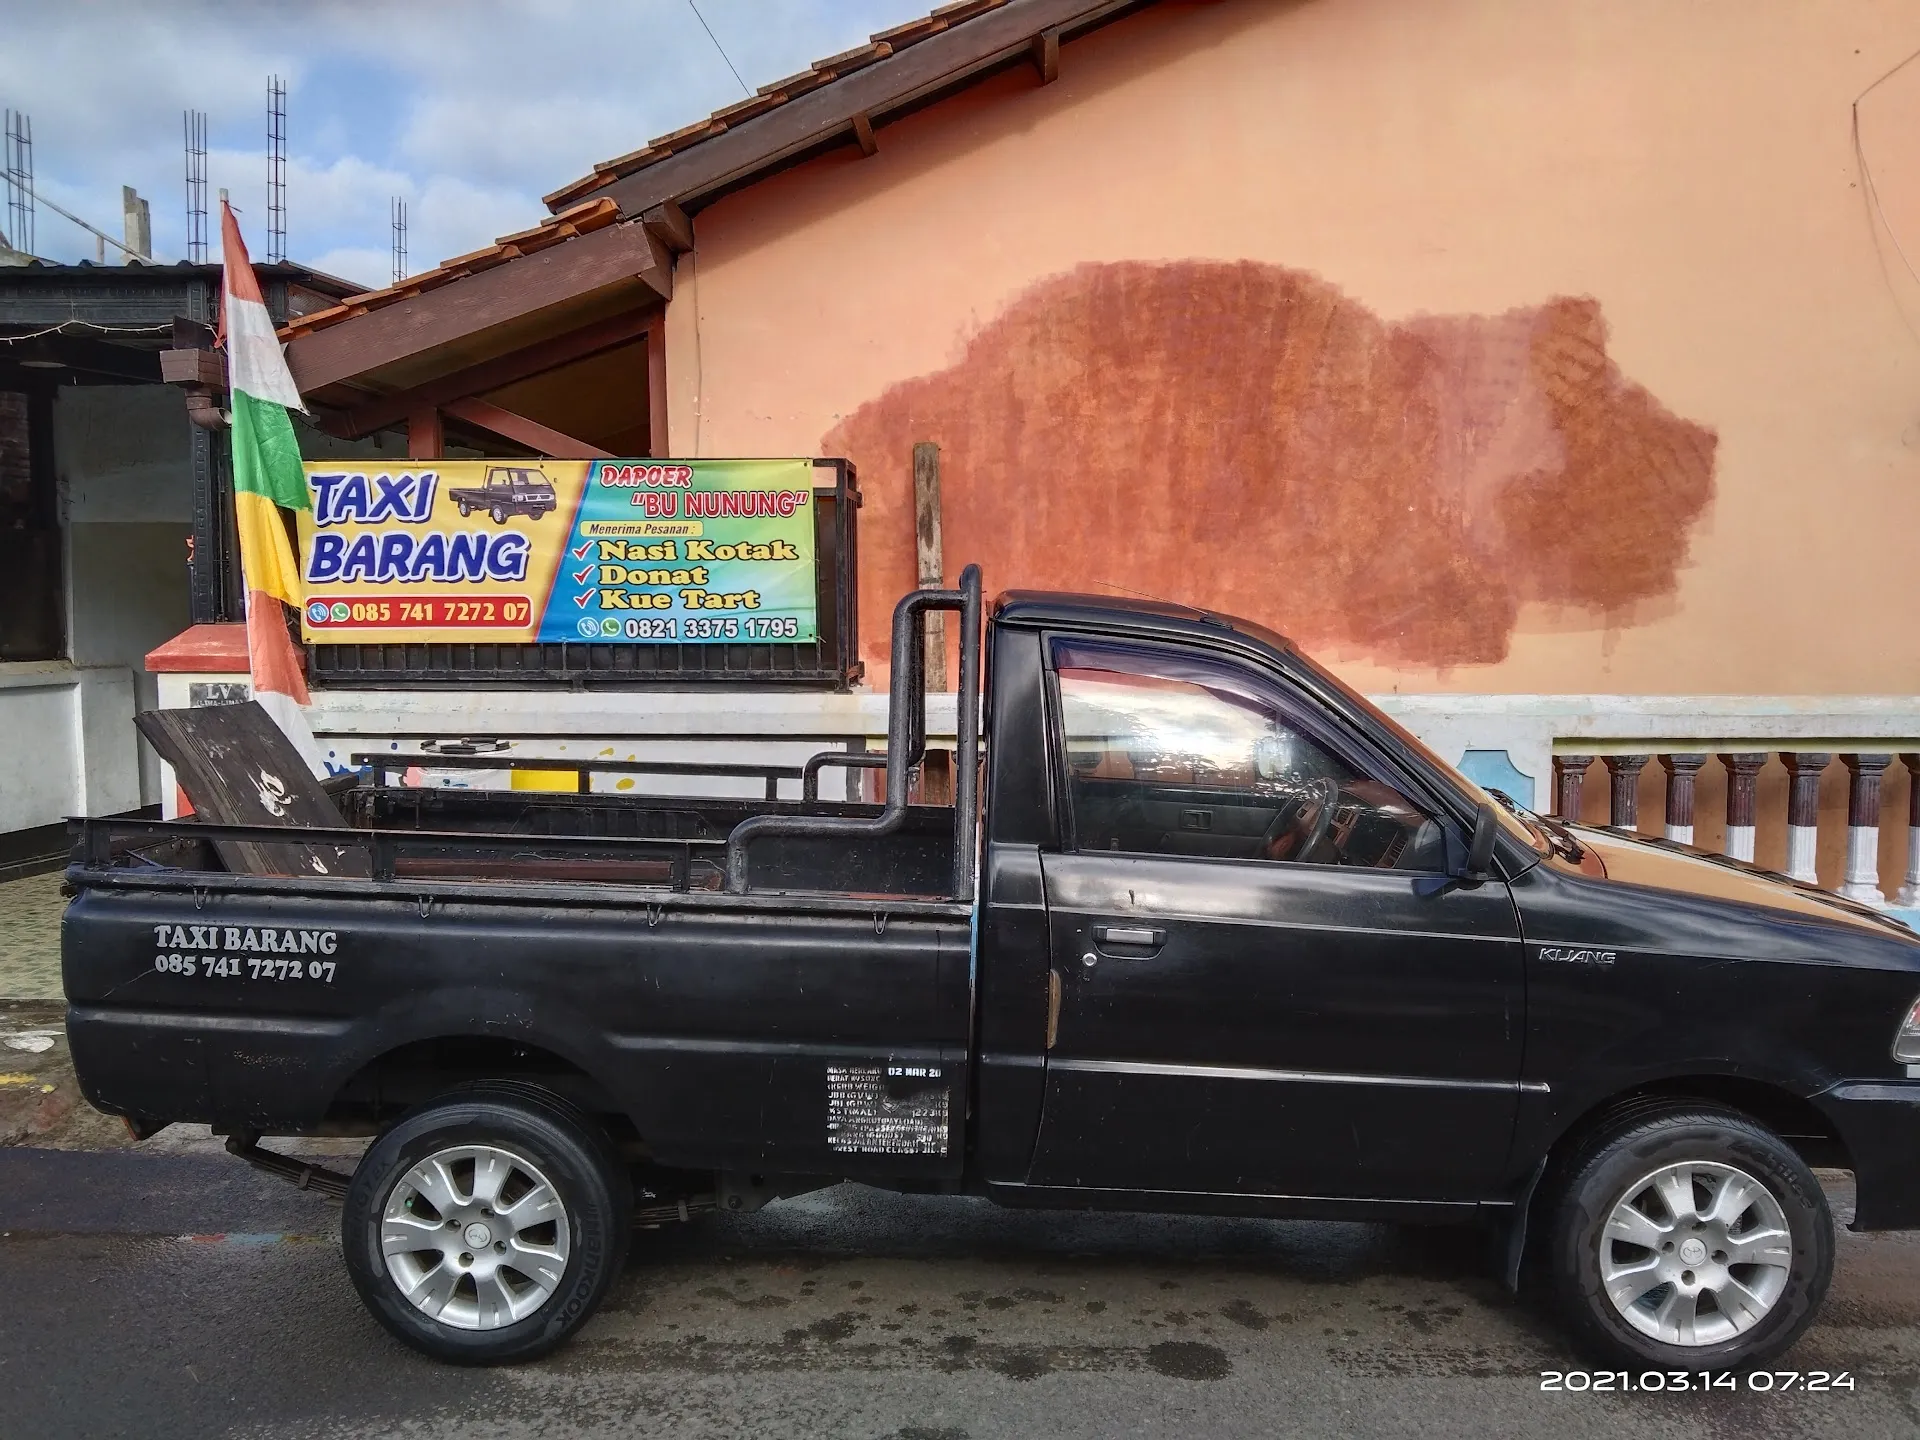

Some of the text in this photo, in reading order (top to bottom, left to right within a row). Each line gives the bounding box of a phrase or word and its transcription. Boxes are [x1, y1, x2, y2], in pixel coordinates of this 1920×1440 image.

[600, 465, 694, 488] DAPOER
[308, 471, 439, 527] TAXI
[589, 524, 641, 535] Menerima
[644, 524, 689, 535] Pesanan
[307, 531, 531, 583] BARANG
[598, 540, 799, 561] Nasi Kotak
[598, 564, 709, 586] Donat
[599, 588, 761, 610] Kue Tart
[352, 603, 529, 621] 085 741 7272 07
[624, 618, 798, 638] 0821 3375 1795
[206, 683, 233, 700] LV
[154, 925, 338, 955] TAXI BARANG
[155, 954, 337, 982] 085 741 7272 07
[888, 1067, 903, 1076] 02
[905, 1067, 927, 1077] MAR
